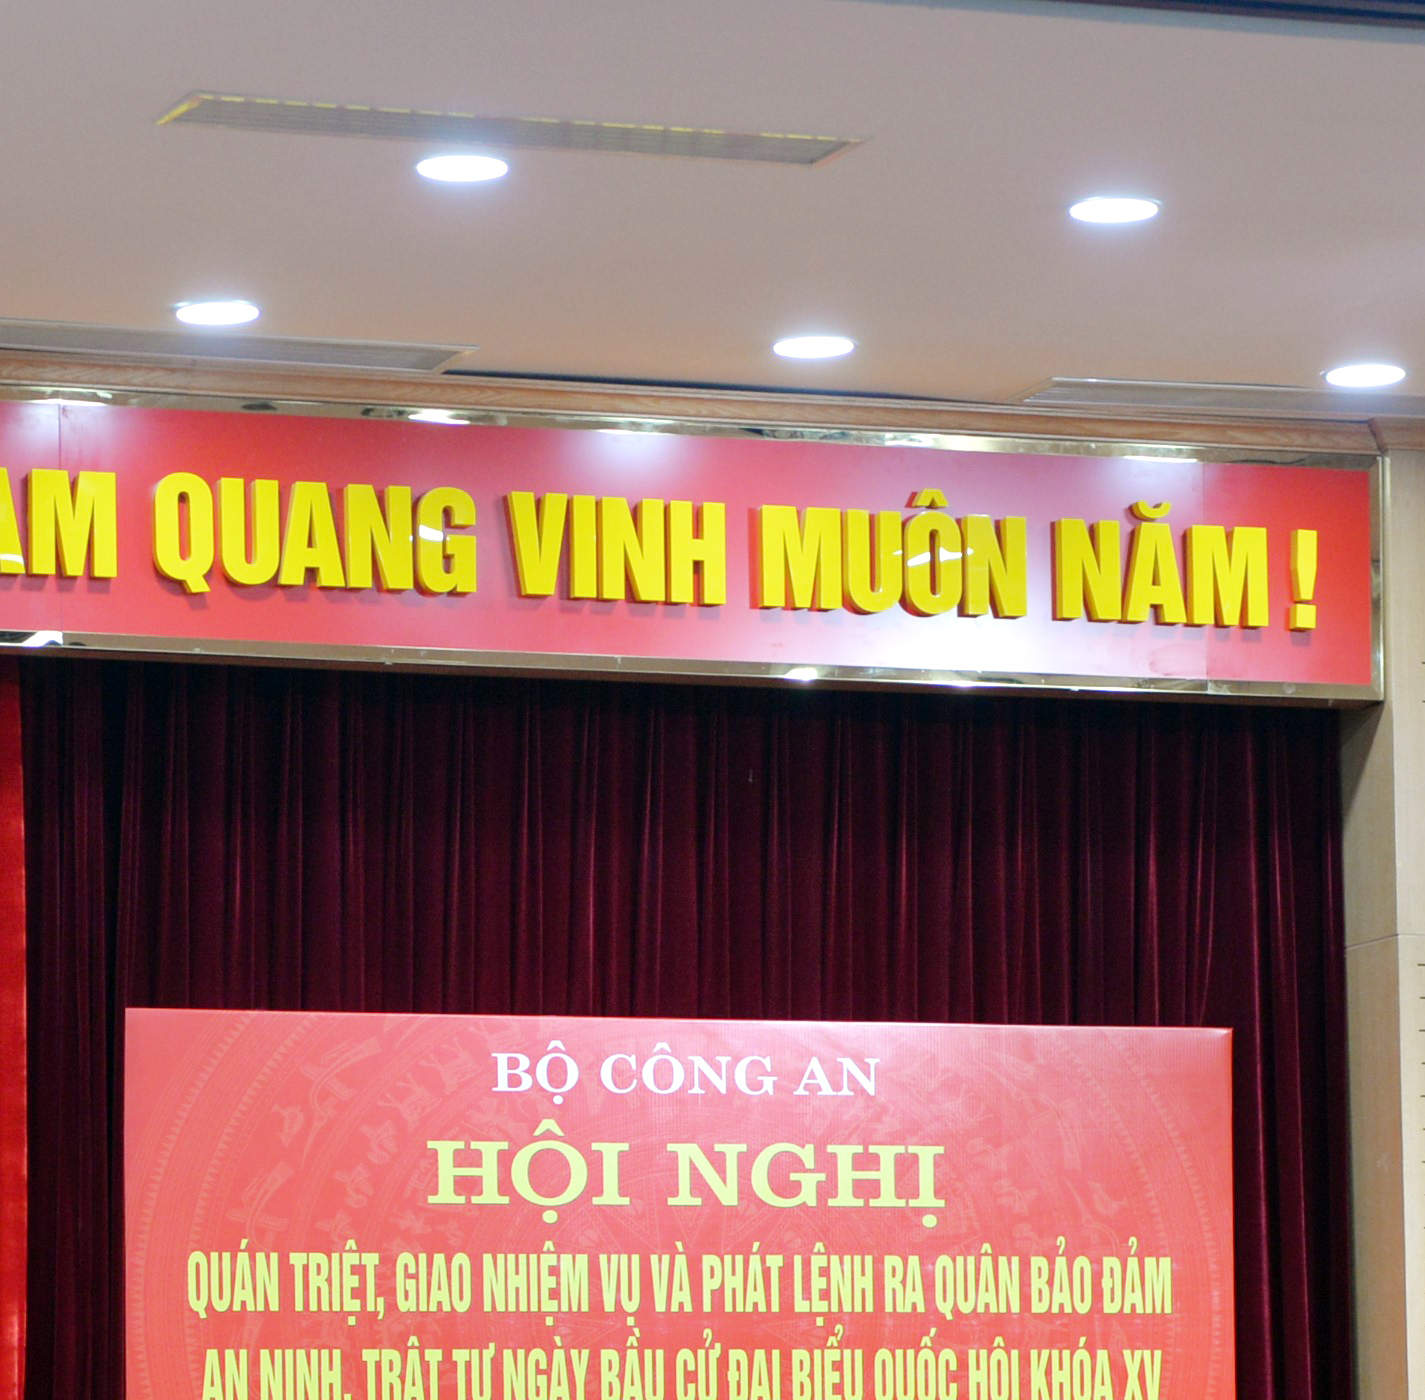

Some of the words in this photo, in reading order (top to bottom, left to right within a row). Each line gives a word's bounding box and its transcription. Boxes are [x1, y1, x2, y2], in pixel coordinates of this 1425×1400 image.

[153, 472, 477, 593] QUANG
[508, 492, 727, 604] VINH
[759, 490, 1026, 616] MUÔN
[1056, 502, 1270, 628] NĂM
[1290, 529, 1318, 629] !
[492, 1040, 578, 1104] BỘ
[601, 1042, 777, 1095] CÔNG
[793, 1057, 880, 1095] AN
[427, 1118, 630, 1223] HỘI
[667, 1142, 945, 1228] NGHỊ
[188, 1239, 279, 1318] QUÁN
[289, 1239, 384, 1325] TRIỆT,
[396, 1252, 471, 1312] GIAO
[483, 1241, 589, 1326] NHIỆM
[599, 1254, 640, 1326] VỤ
[650, 1241, 692, 1312] VÀ
[702, 1242, 783, 1312] PHÁT
[794, 1242, 873, 1326] LỆNH
[884, 1255, 925, 1312] RA
[935, 1243, 1020, 1320] QUÂN
[1031, 1236, 1092, 1314] BẢO
[1102, 1237, 1172, 1314] ĐẢM
